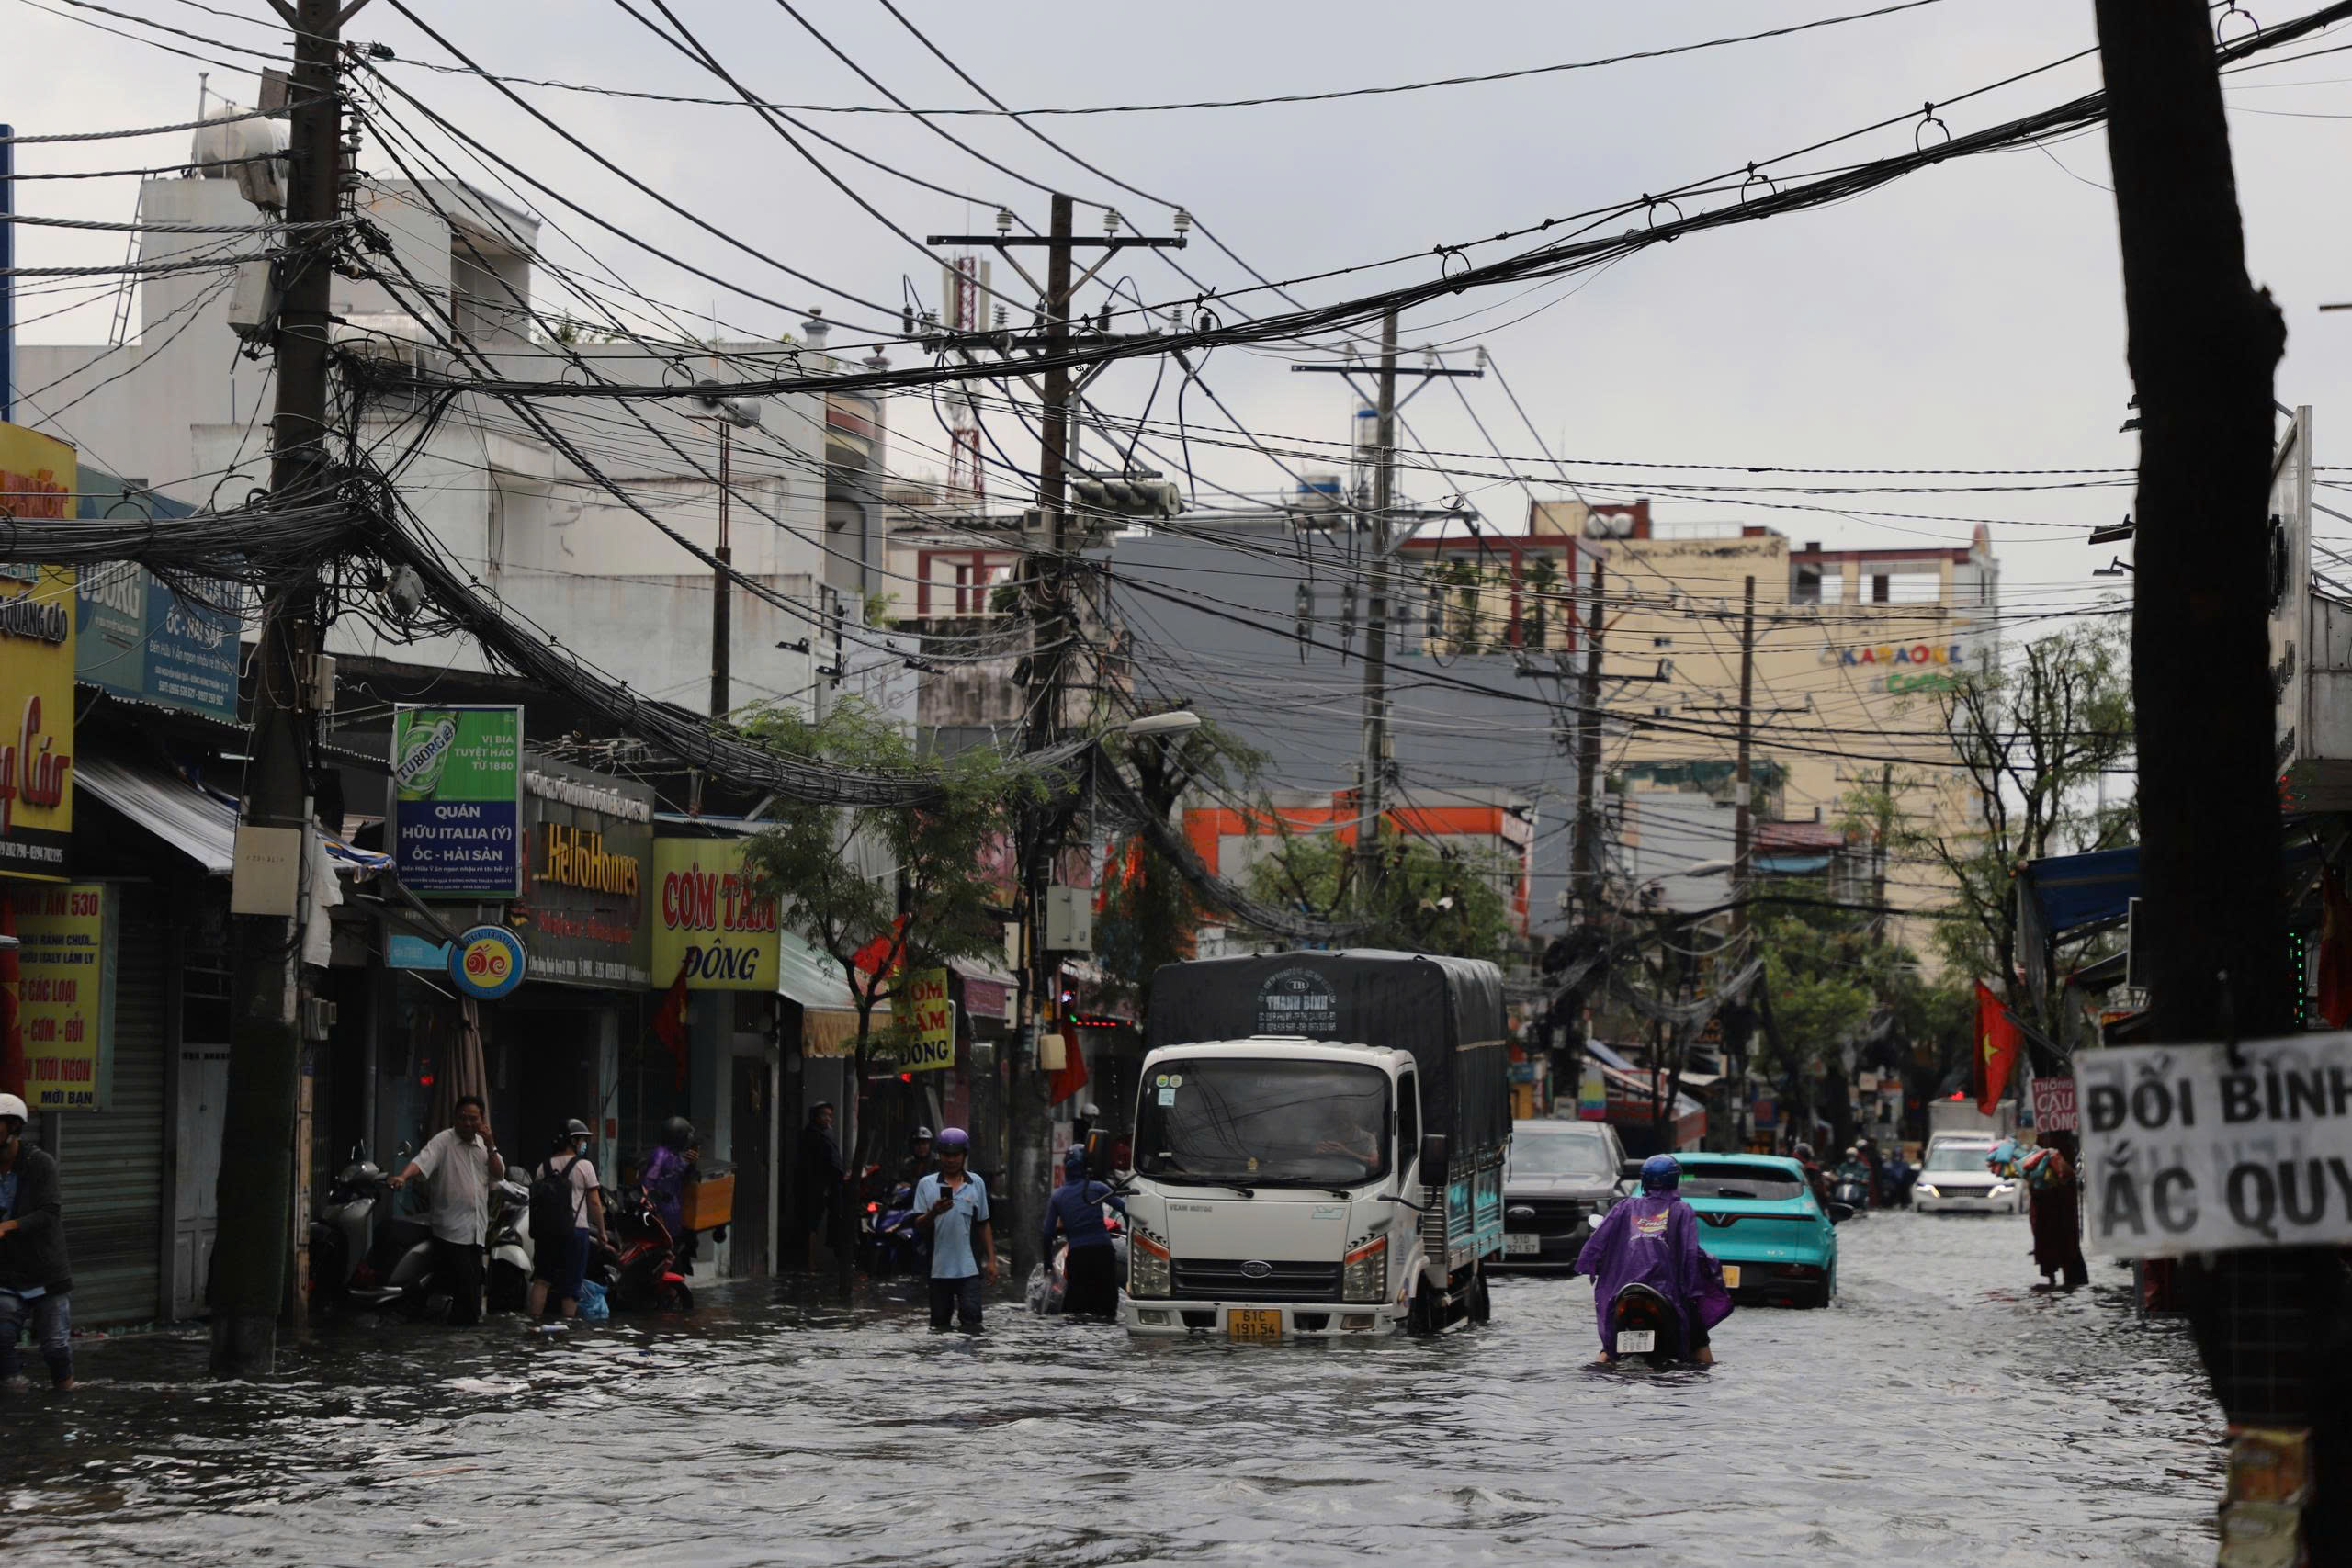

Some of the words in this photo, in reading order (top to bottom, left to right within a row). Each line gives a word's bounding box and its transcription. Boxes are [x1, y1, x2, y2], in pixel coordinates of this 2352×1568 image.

[495, 735, 514, 743] BIA
[397, 735, 446, 780] TUBORG
[490, 761, 514, 771] 1880
[435, 804, 481, 819] QUÁN
[402, 824, 436, 839] HỮU
[440, 827, 488, 839] ITALIA
[492, 824, 512, 840] (Ý)
[412, 845, 433, 861] ỐC
[444, 846, 469, 861] HẢI
[472, 846, 503, 861] SẢN
[72, 893, 98, 916] 530
[662, 862, 717, 931] CƠM
[684, 938, 760, 980] ĐÔNG
[28, 976, 50, 1002] CÁC
[52, 979, 76, 1007] LOẠI
[1266, 995, 1301, 1010] THANH
[30, 1016, 55, 1042] CƠM
[61, 1057, 90, 1081] NGON
[68, 1091, 93, 1107] BẠN
[2088, 1054, 2195, 1134] ĐỔI
[2101, 1139, 2199, 1237] ẮC
[1242, 1310, 1266, 1322] 61C
